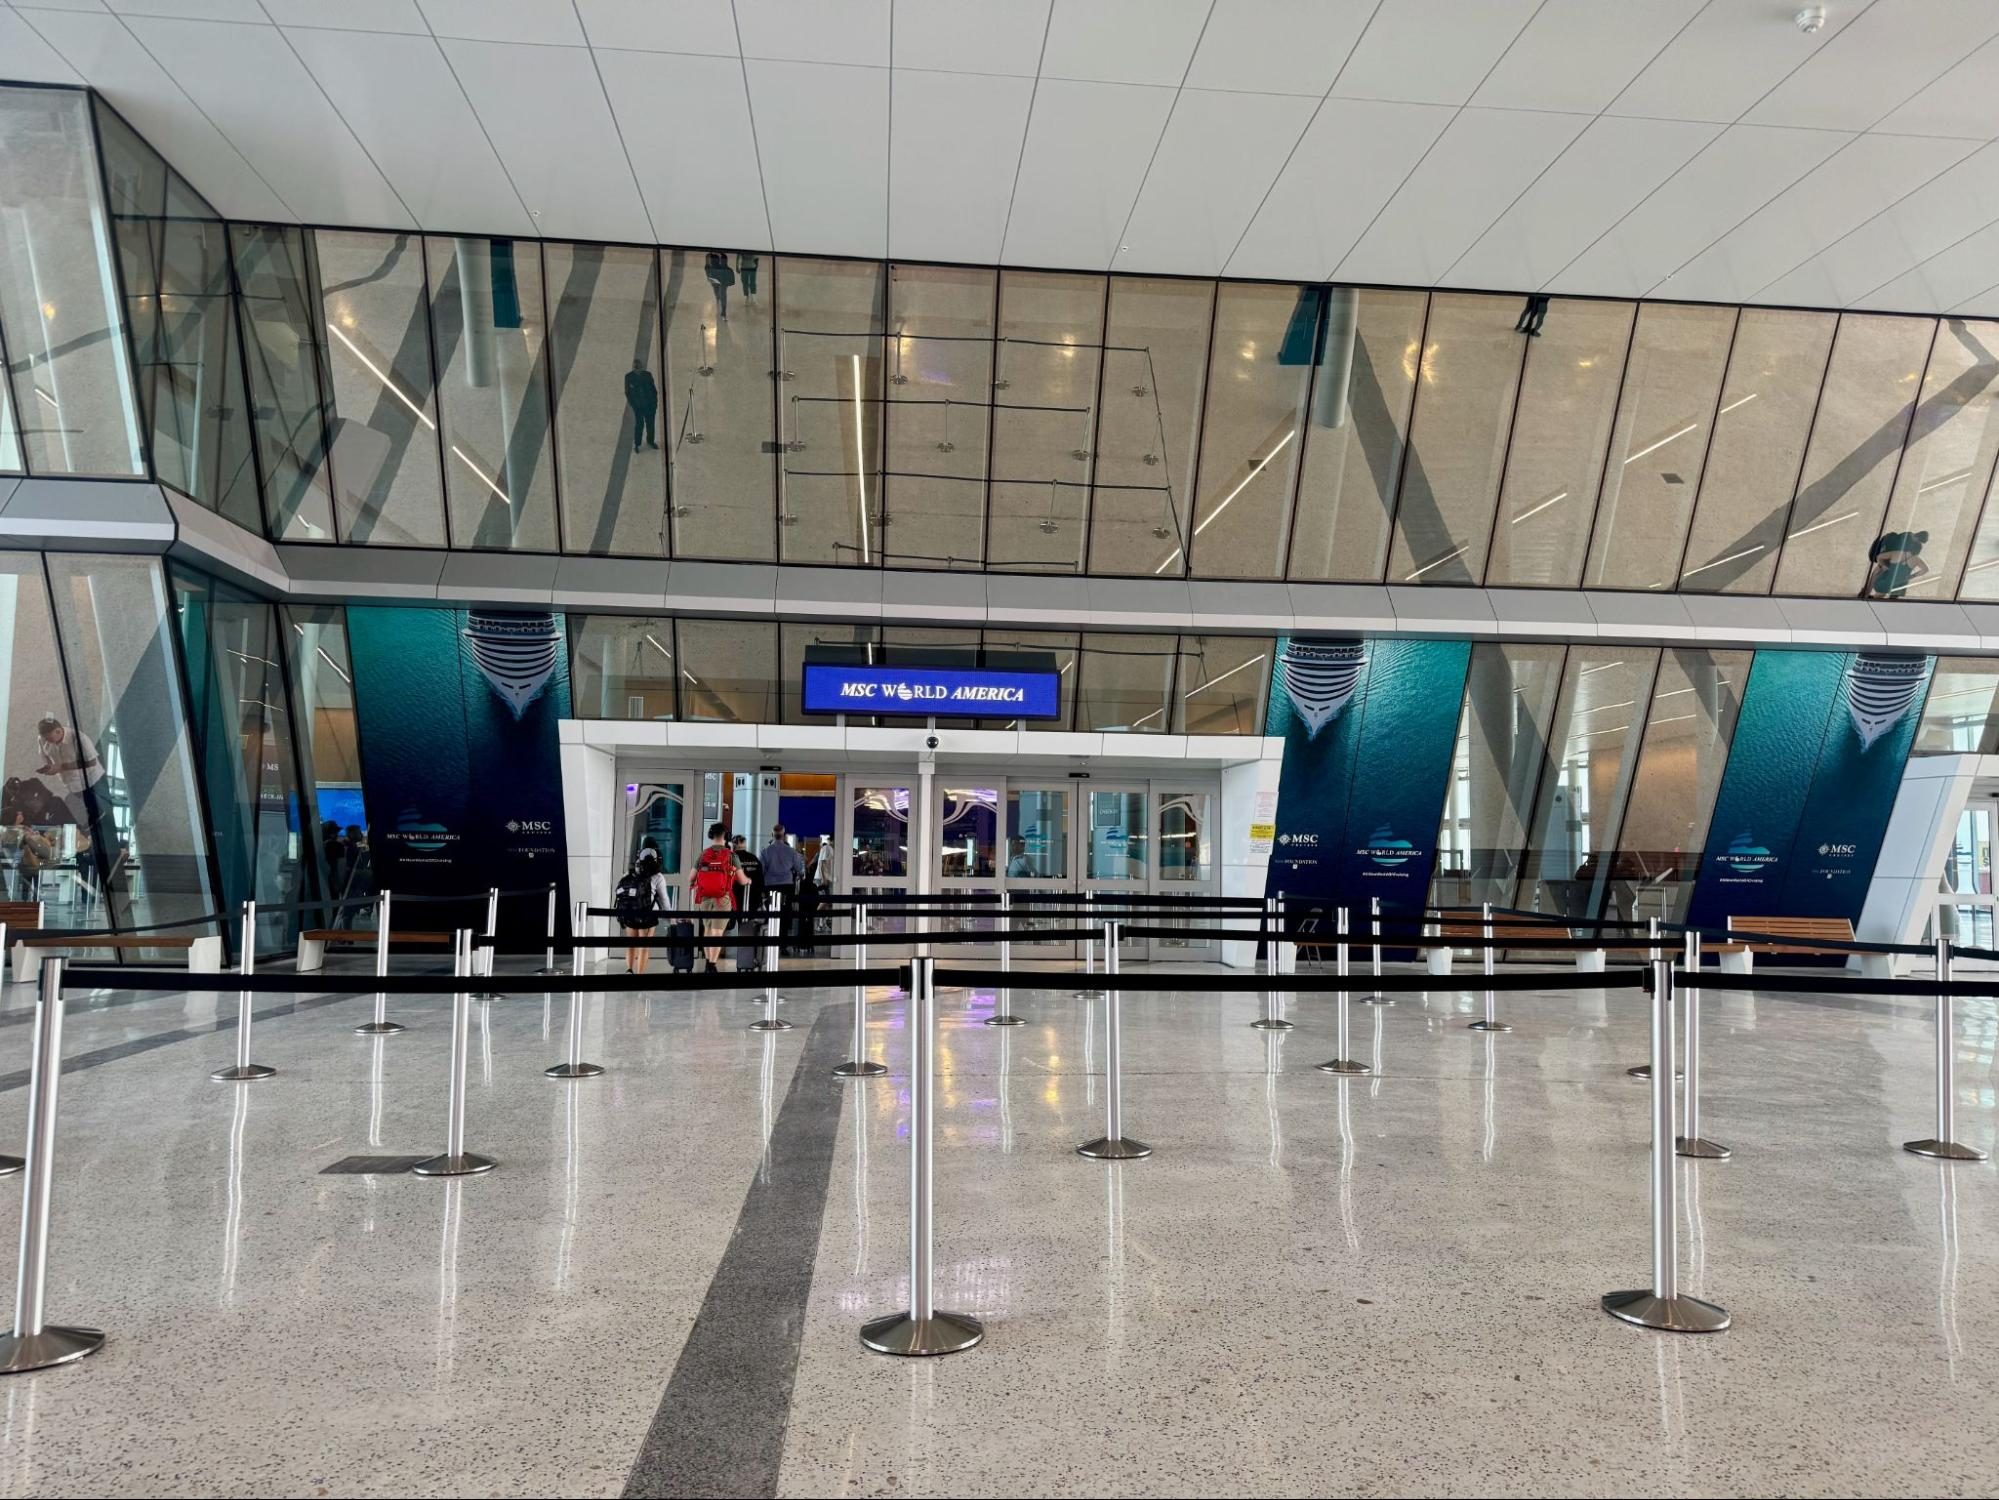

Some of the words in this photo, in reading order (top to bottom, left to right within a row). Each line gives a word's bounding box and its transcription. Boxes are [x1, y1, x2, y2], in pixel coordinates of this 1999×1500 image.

[840, 682, 877, 697] MSC
[883, 682, 947, 701] WORLD
[951, 687, 1025, 702] AMERICA
[521, 821, 552, 831] MSC
[1291, 833, 1319, 844] MSC
[1829, 844, 1857, 854] MSC
